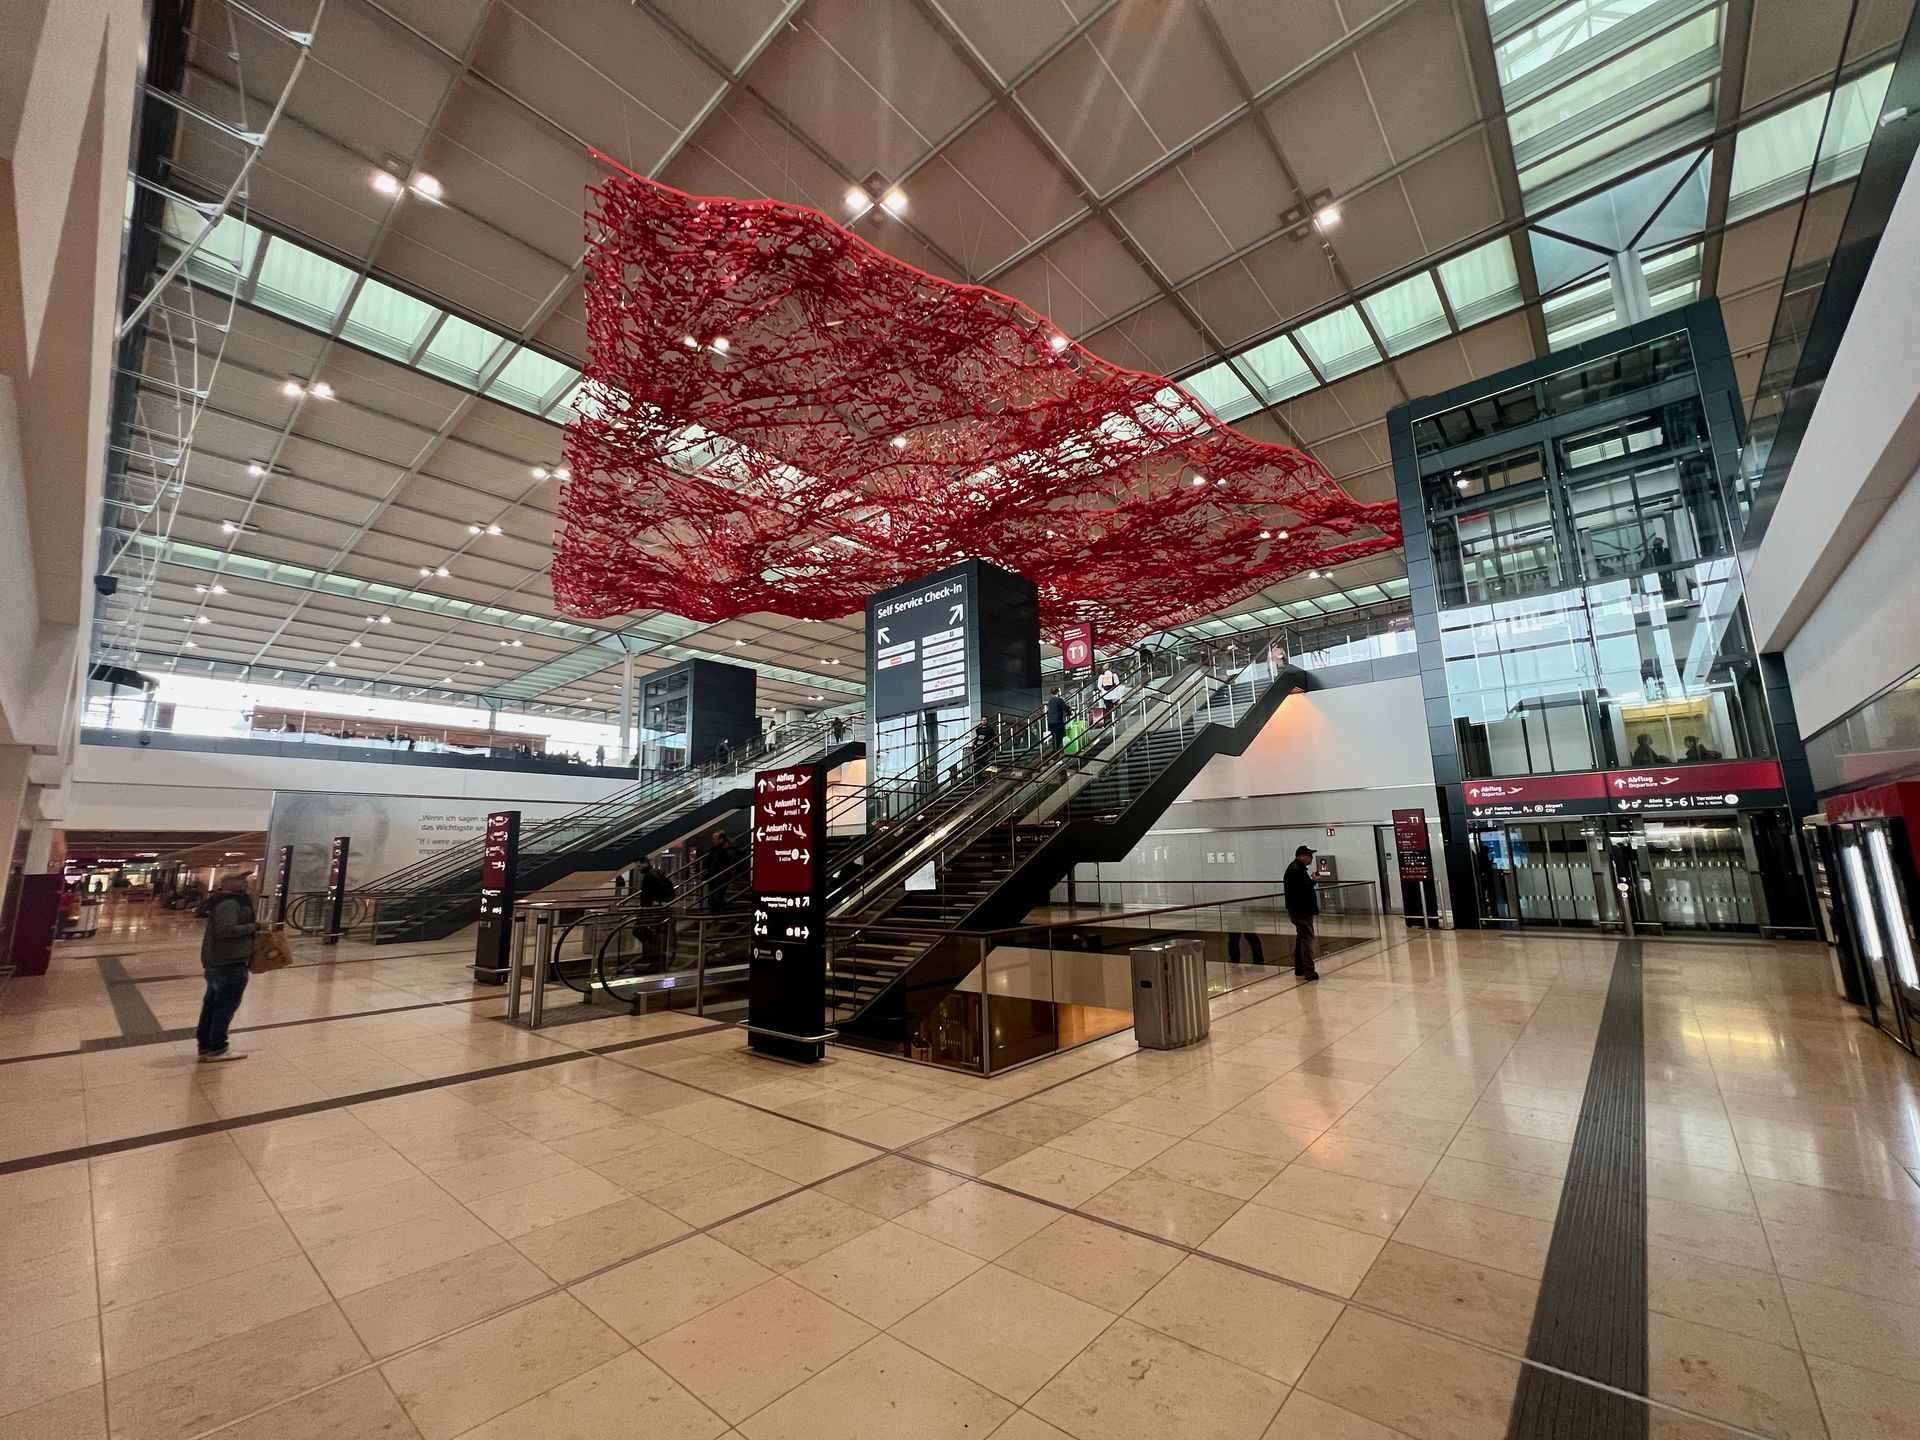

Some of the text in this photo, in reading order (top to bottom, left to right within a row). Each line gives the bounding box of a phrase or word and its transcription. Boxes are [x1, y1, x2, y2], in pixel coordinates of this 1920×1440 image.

[878, 582, 962, 619] Self Service Check-in
[1069, 645, 1083, 659] T1
[777, 773, 795, 782] Abflug
[775, 798, 796, 808] Ankunft
[766, 823, 792, 832] Ankunft 2
